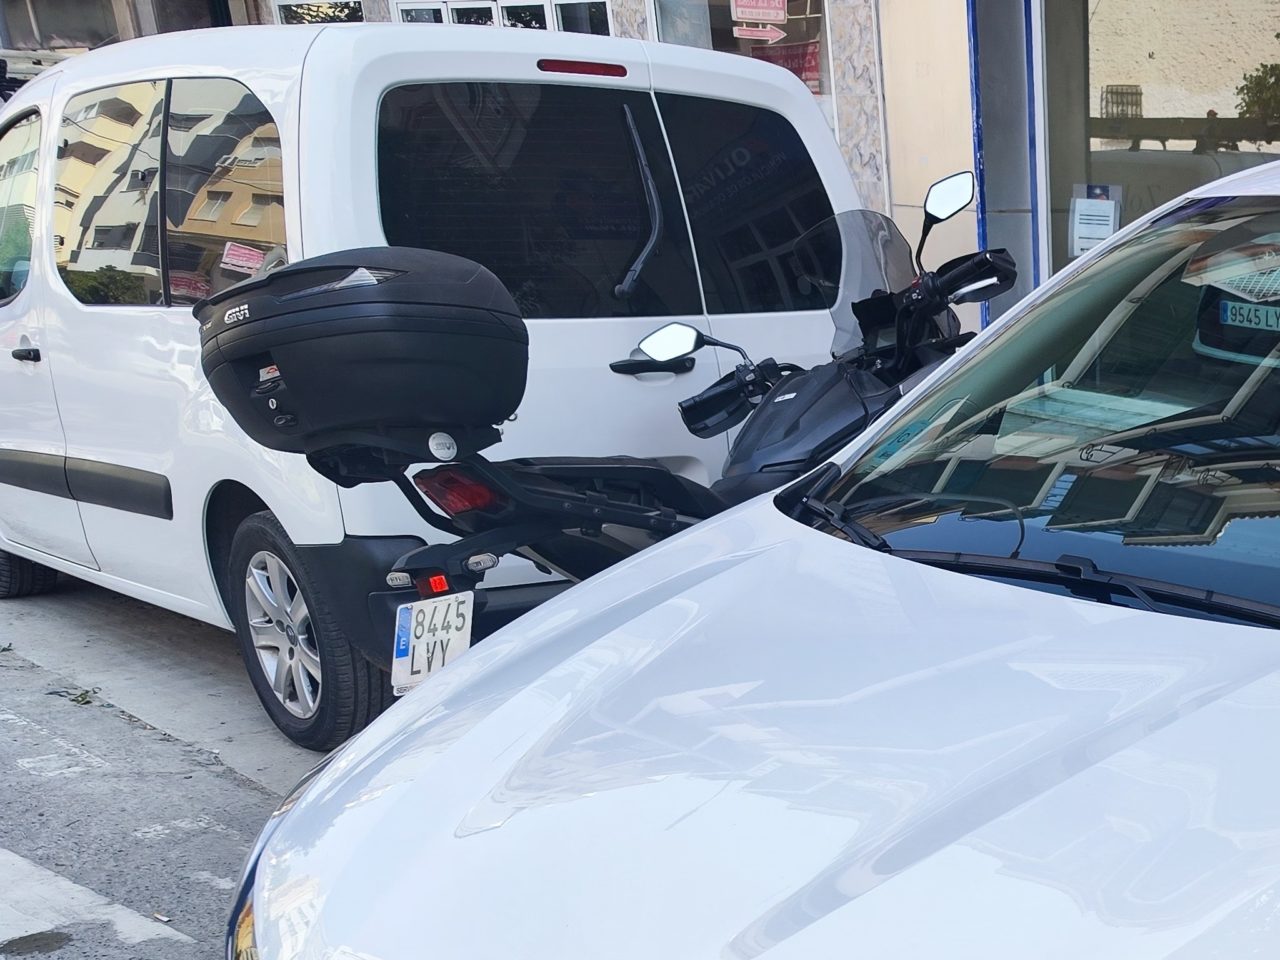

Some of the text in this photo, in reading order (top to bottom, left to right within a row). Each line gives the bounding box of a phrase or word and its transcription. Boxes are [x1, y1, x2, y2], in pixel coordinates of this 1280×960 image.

[224, 303, 250, 325] GIVI
[1230, 305, 1262, 327] 9545
[414, 600, 466, 640] 8445
[399, 637, 407, 650] E
[410, 638, 451, 676] LVY
